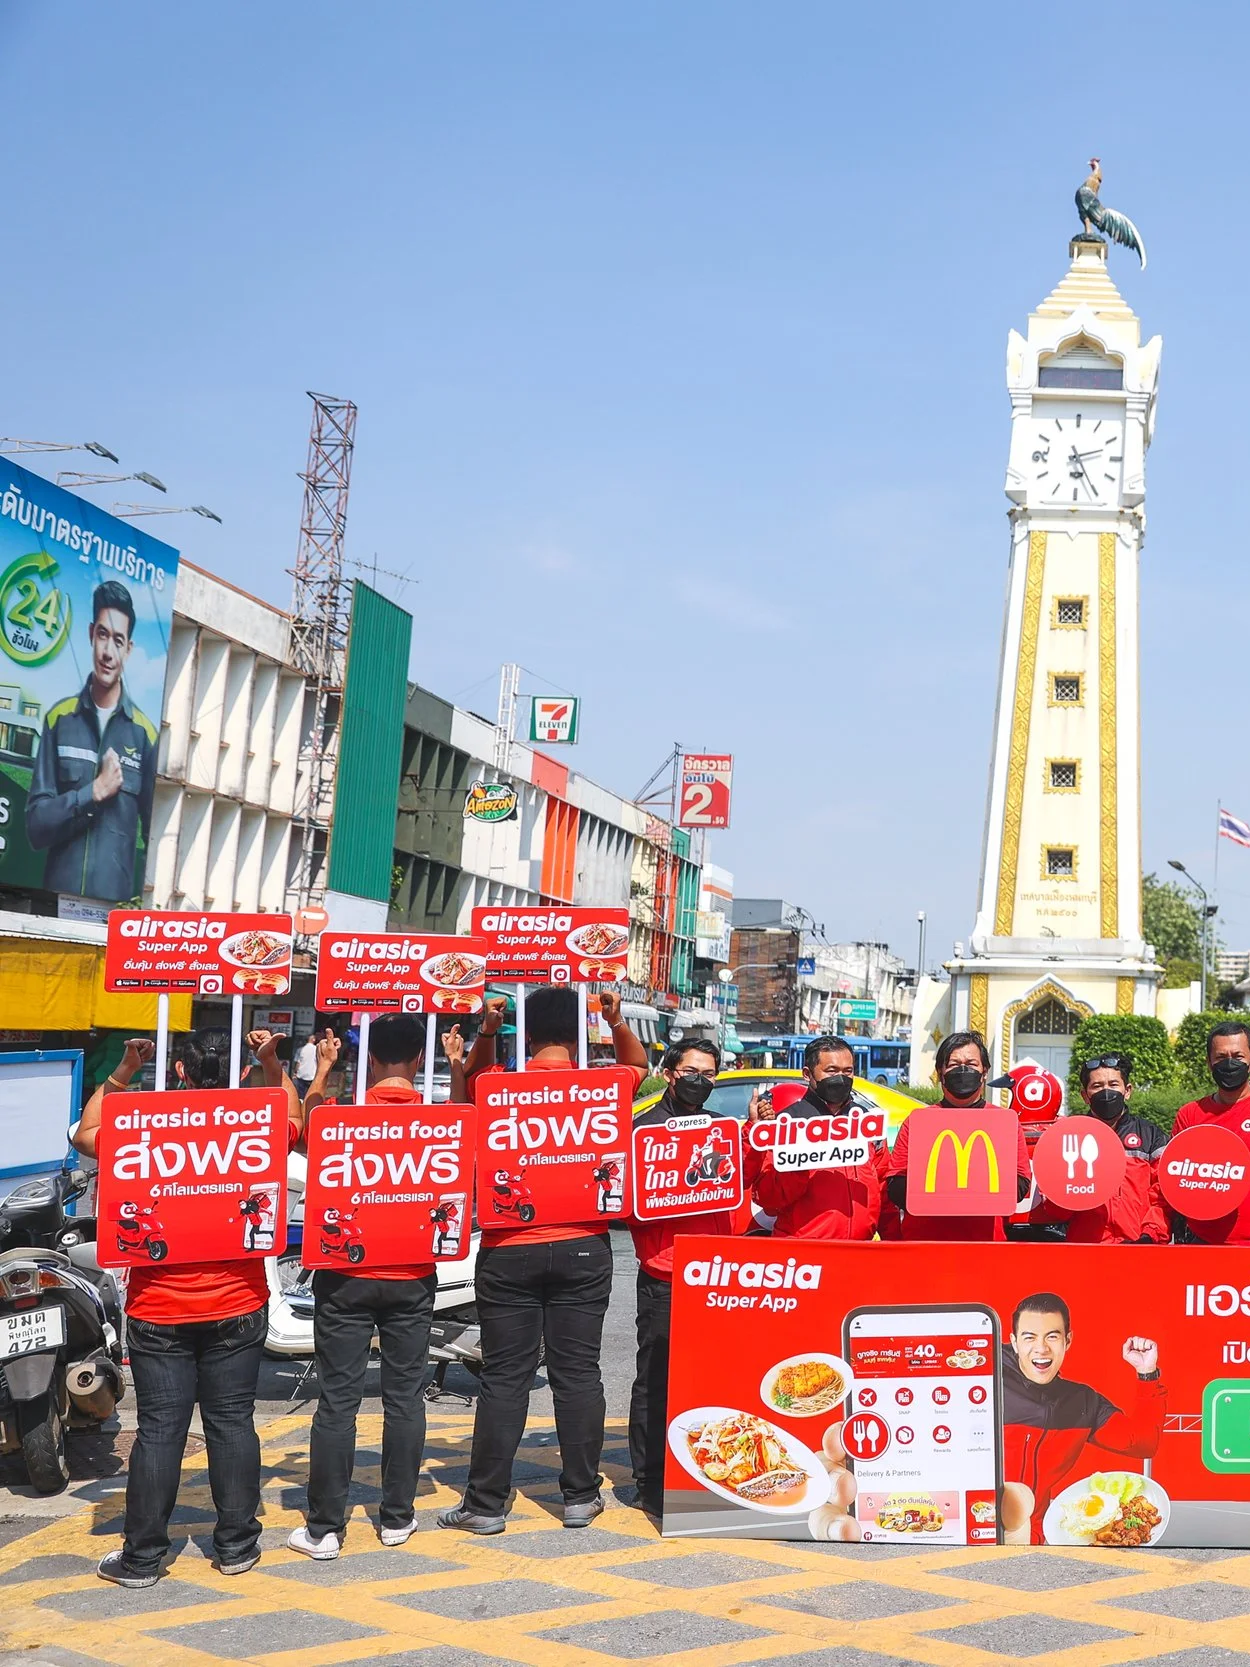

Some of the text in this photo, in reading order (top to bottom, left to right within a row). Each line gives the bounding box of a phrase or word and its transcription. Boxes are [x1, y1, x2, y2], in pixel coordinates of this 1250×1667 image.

[0, 483, 164, 592] ดับมาตรฐานบริการ
[8, 578, 60, 639] 24
[12, 628, 39, 651] ชั่วโมง
[685, 756, 730, 771] จักรวาล
[120, 916, 227, 938] airasia
[481, 912, 572, 931] airasia
[138, 941, 208, 954] Super App
[330, 938, 427, 960] airasia
[497, 934, 557, 946] Super App
[124, 959, 152, 971] อิ่มคุ้ม
[189, 959, 219, 971] สั่งเลย
[486, 951, 510, 962] อิ่มคุ้ม
[541, 952, 566, 961] สั่งเลย
[346, 962, 410, 974] Super App
[334, 978, 359, 991] อิ่มคุ้ม
[393, 979, 420, 991] สั่งเลย
[488, 1083, 618, 1106] airasia food
[114, 1104, 272, 1130] airasia food
[488, 1103, 618, 1150] ส่งฟรี
[679, 1118, 706, 1128] xpress
[321, 1120, 462, 1141] airasia food
[753, 1110, 884, 1147] airasia
[113, 1126, 271, 1180] ส่งฟรี
[644, 1136, 680, 1162] ใกล้
[777, 1147, 864, 1166] Super App
[319, 1140, 460, 1188] ส่งฟรี
[519, 1152, 596, 1166] 6 กิโลเมตรแรก
[644, 1165, 678, 1190] ไกล
[1168, 1158, 1245, 1180] airasia
[150, 1181, 243, 1197] 6 กิโลเมตรแรก
[1066, 1183, 1095, 1194] Food
[1179, 1179, 1230, 1192] Super App
[351, 1190, 433, 1204] 6 กิโลเมตรแรก
[646, 1186, 734, 1209] พี่พร้อมส่งถึงบ้าน
[683, 1256, 822, 1290] airasia
[706, 1292, 798, 1312] Super App
[8, 1336, 46, 1354] 472
[914, 1344, 935, 1358] 40
[858, 1470, 884, 1478] Delivery
